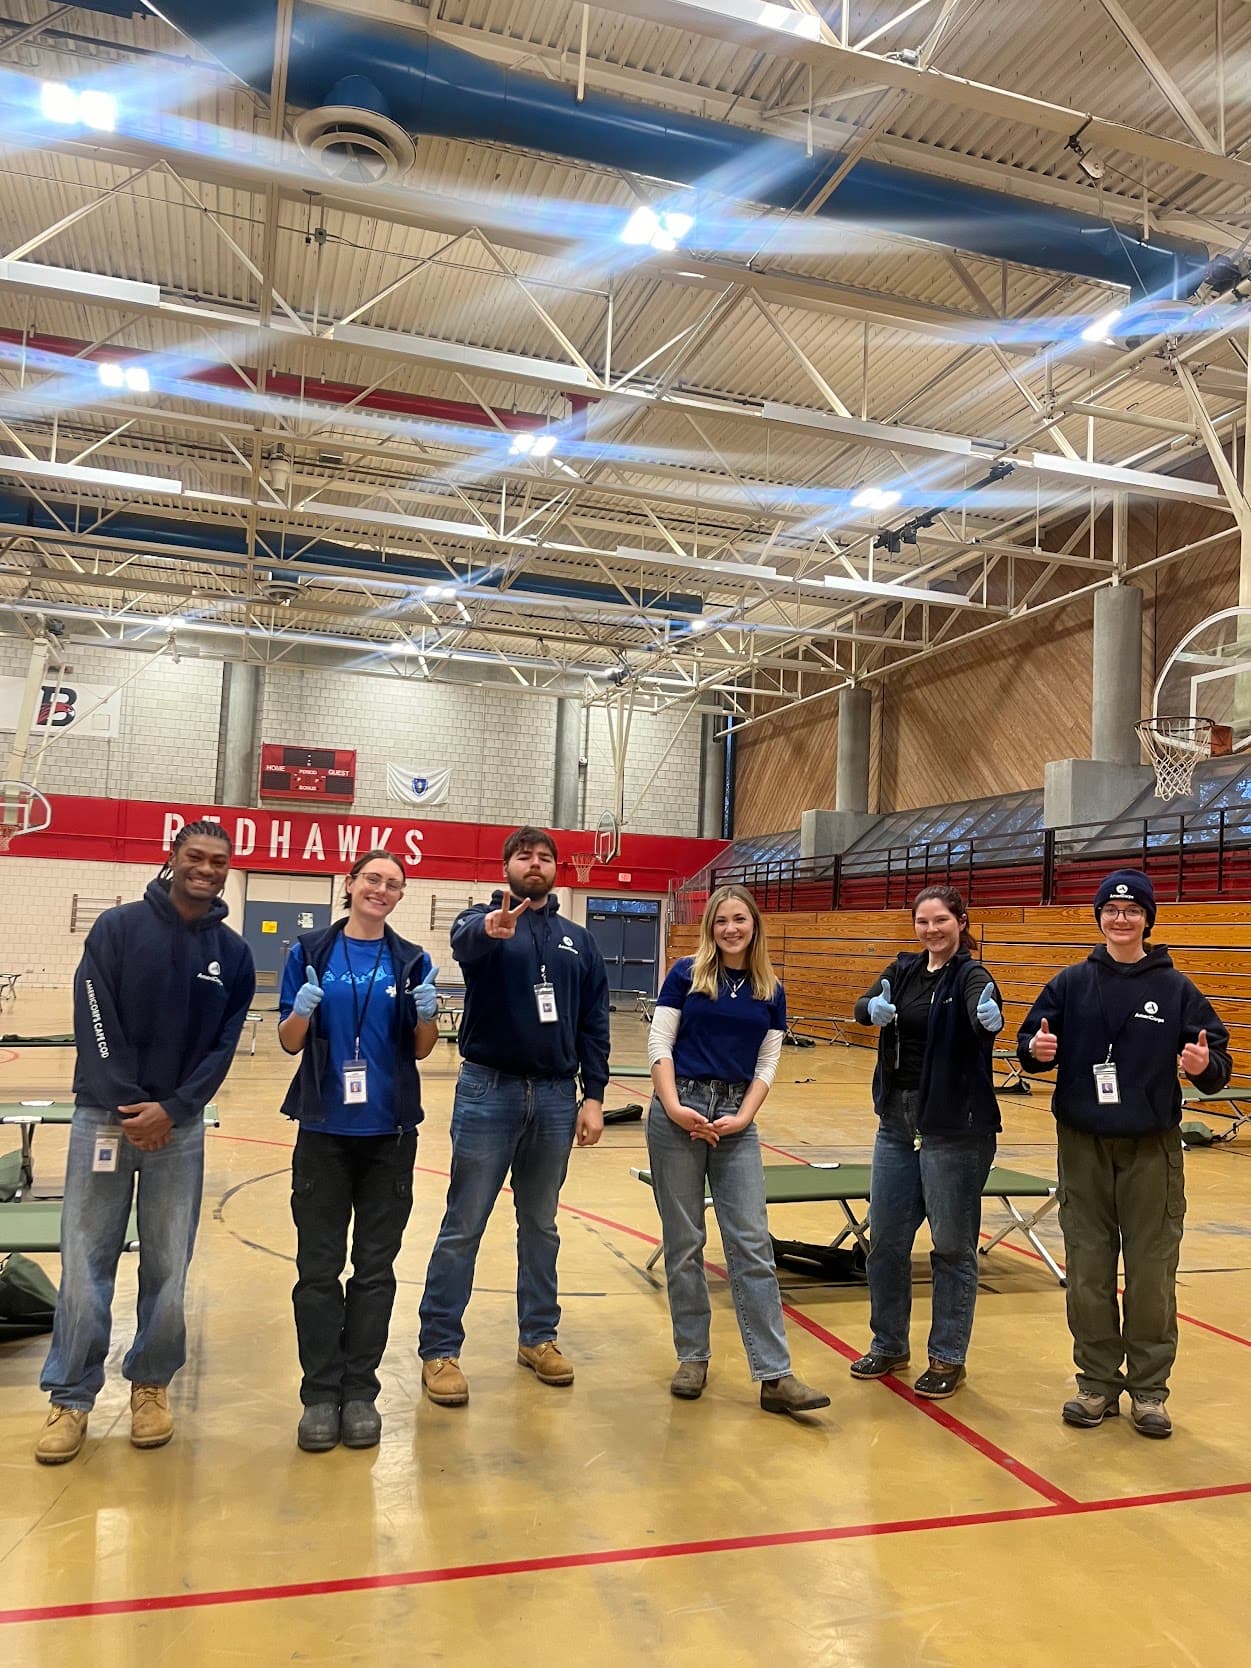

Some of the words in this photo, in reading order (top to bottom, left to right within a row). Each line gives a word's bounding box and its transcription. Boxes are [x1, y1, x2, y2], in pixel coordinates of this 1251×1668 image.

[265, 764, 286, 772] HOME
[161, 812, 424, 866] RDHAWKS
[84, 979, 102, 1022] AMERICORPS
[1134, 1012, 1165, 1023] AmeriCorps
[93, 1022, 106, 1042] CAPE
[98, 1041, 110, 1059] COD
